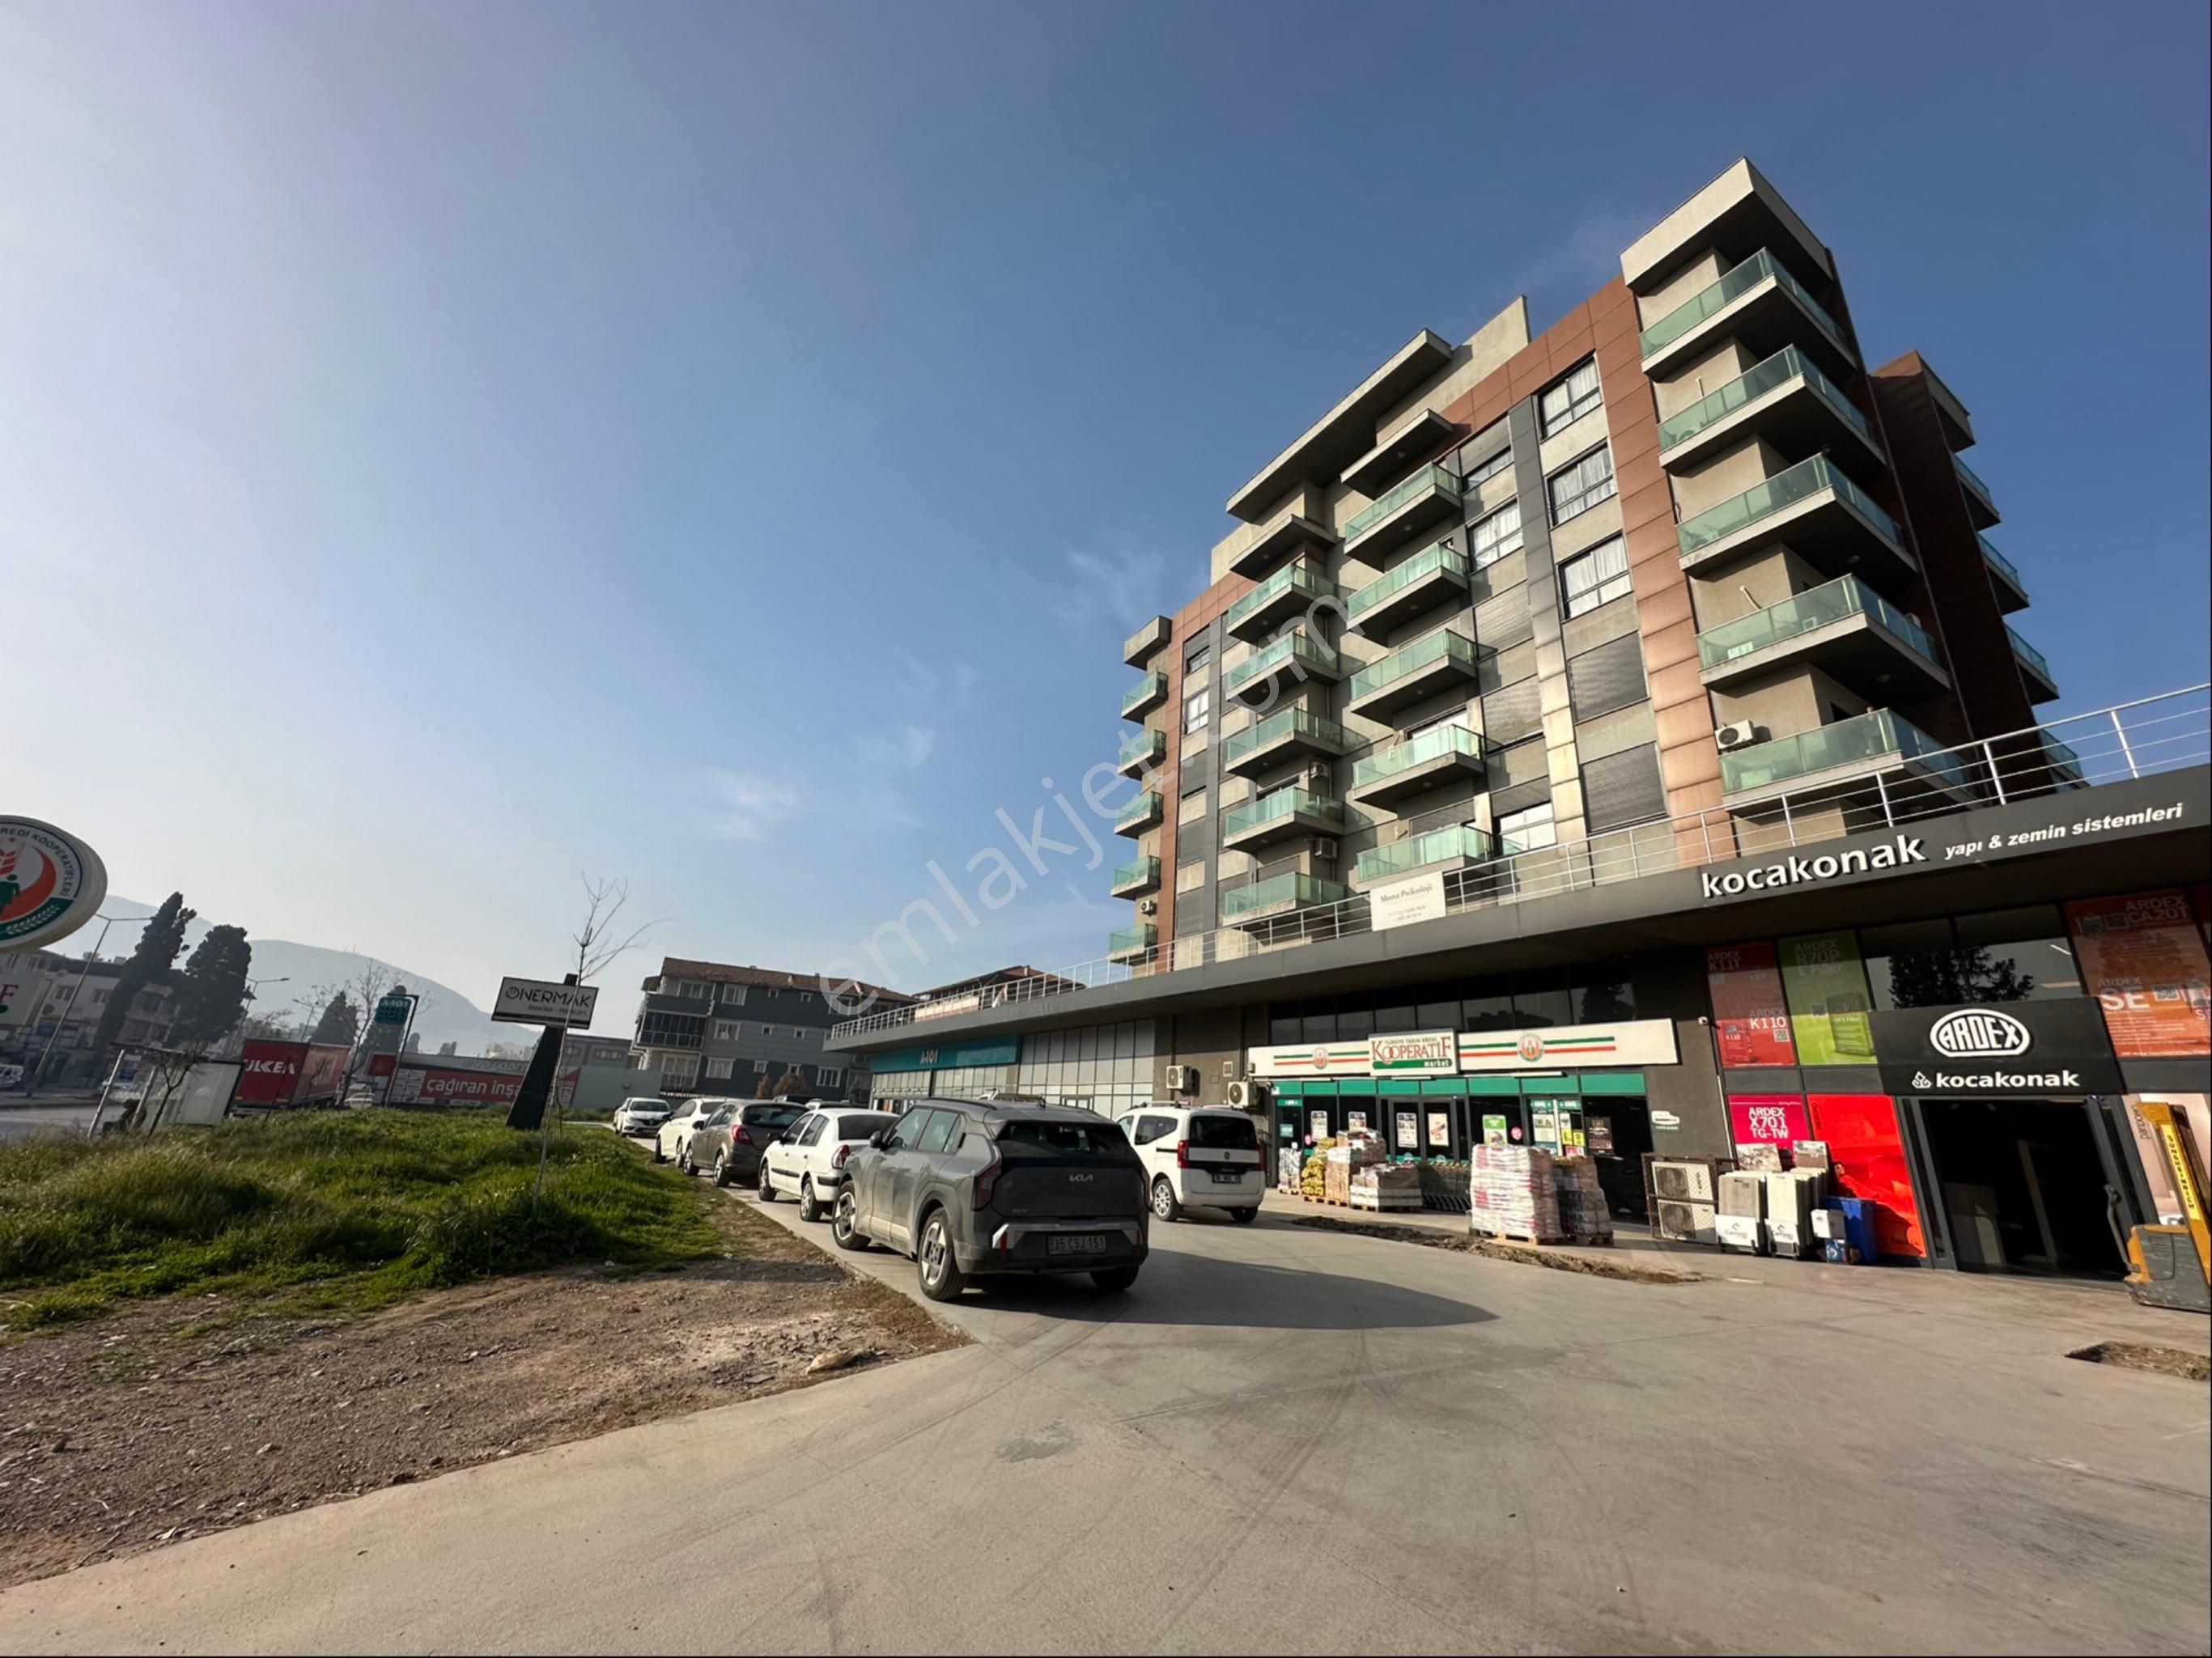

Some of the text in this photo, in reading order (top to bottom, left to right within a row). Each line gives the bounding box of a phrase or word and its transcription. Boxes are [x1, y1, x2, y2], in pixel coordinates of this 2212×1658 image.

[1701, 803, 2184, 898] kocakonak yapı & zemin sistemleri
[2125, 895, 2187, 912] ARDEX
[1750, 1016, 1786, 1029] K110
[1938, 1015, 2022, 1051] ARDEX
[1424, 1059, 1450, 1067] market
[1936, 1070, 2080, 1088] kocakonak
[1748, 1107, 1785, 1117] ARDEX
[1749, 1116, 1787, 1129] X701
[1750, 1128, 1789, 1139] TG-TW
[1088, 1237, 1104, 1249] 151
